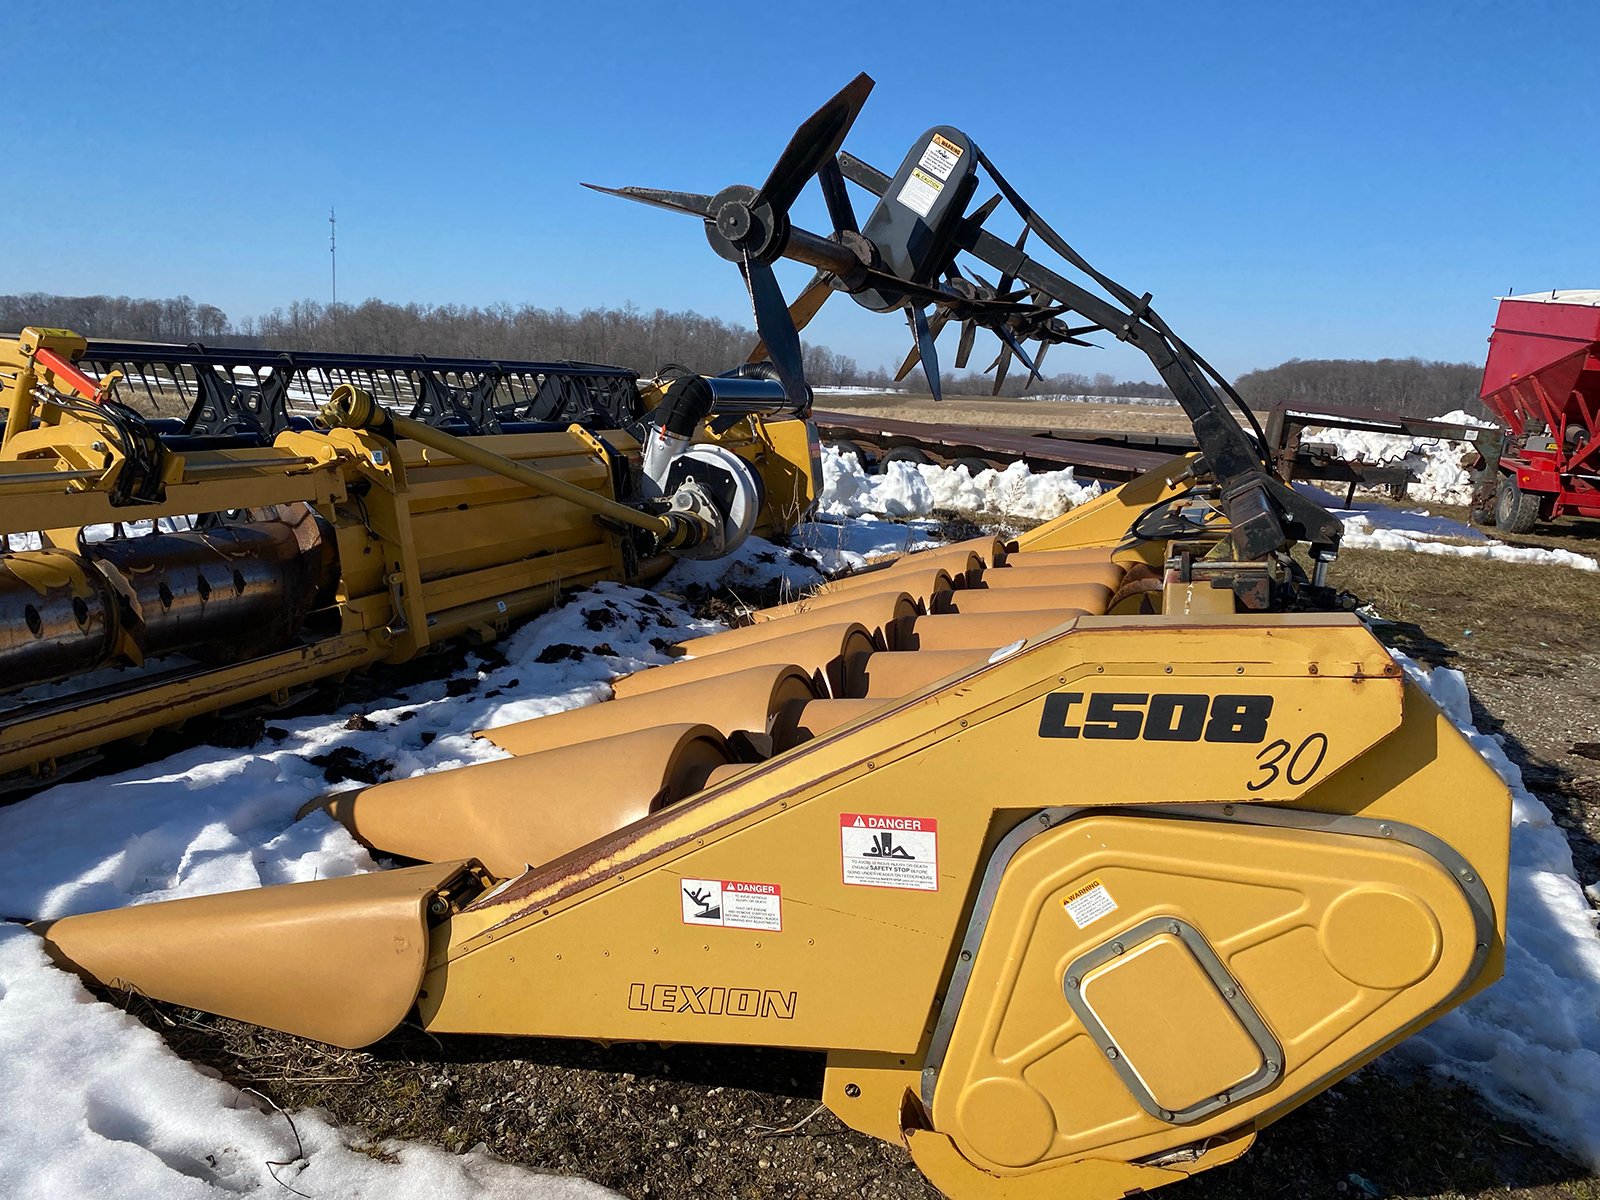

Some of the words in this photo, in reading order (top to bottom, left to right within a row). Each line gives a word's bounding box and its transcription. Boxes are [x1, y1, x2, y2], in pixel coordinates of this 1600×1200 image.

[941, 139, 961, 155] WARNING
[920, 174, 940, 189] CAUTION
[1038, 692, 1274, 743] C508
[1247, 732, 1328, 791] 30
[868, 817, 921, 830] DANGER
[737, 884, 774, 893] DANGER
[1068, 880, 1100, 901] WARNING
